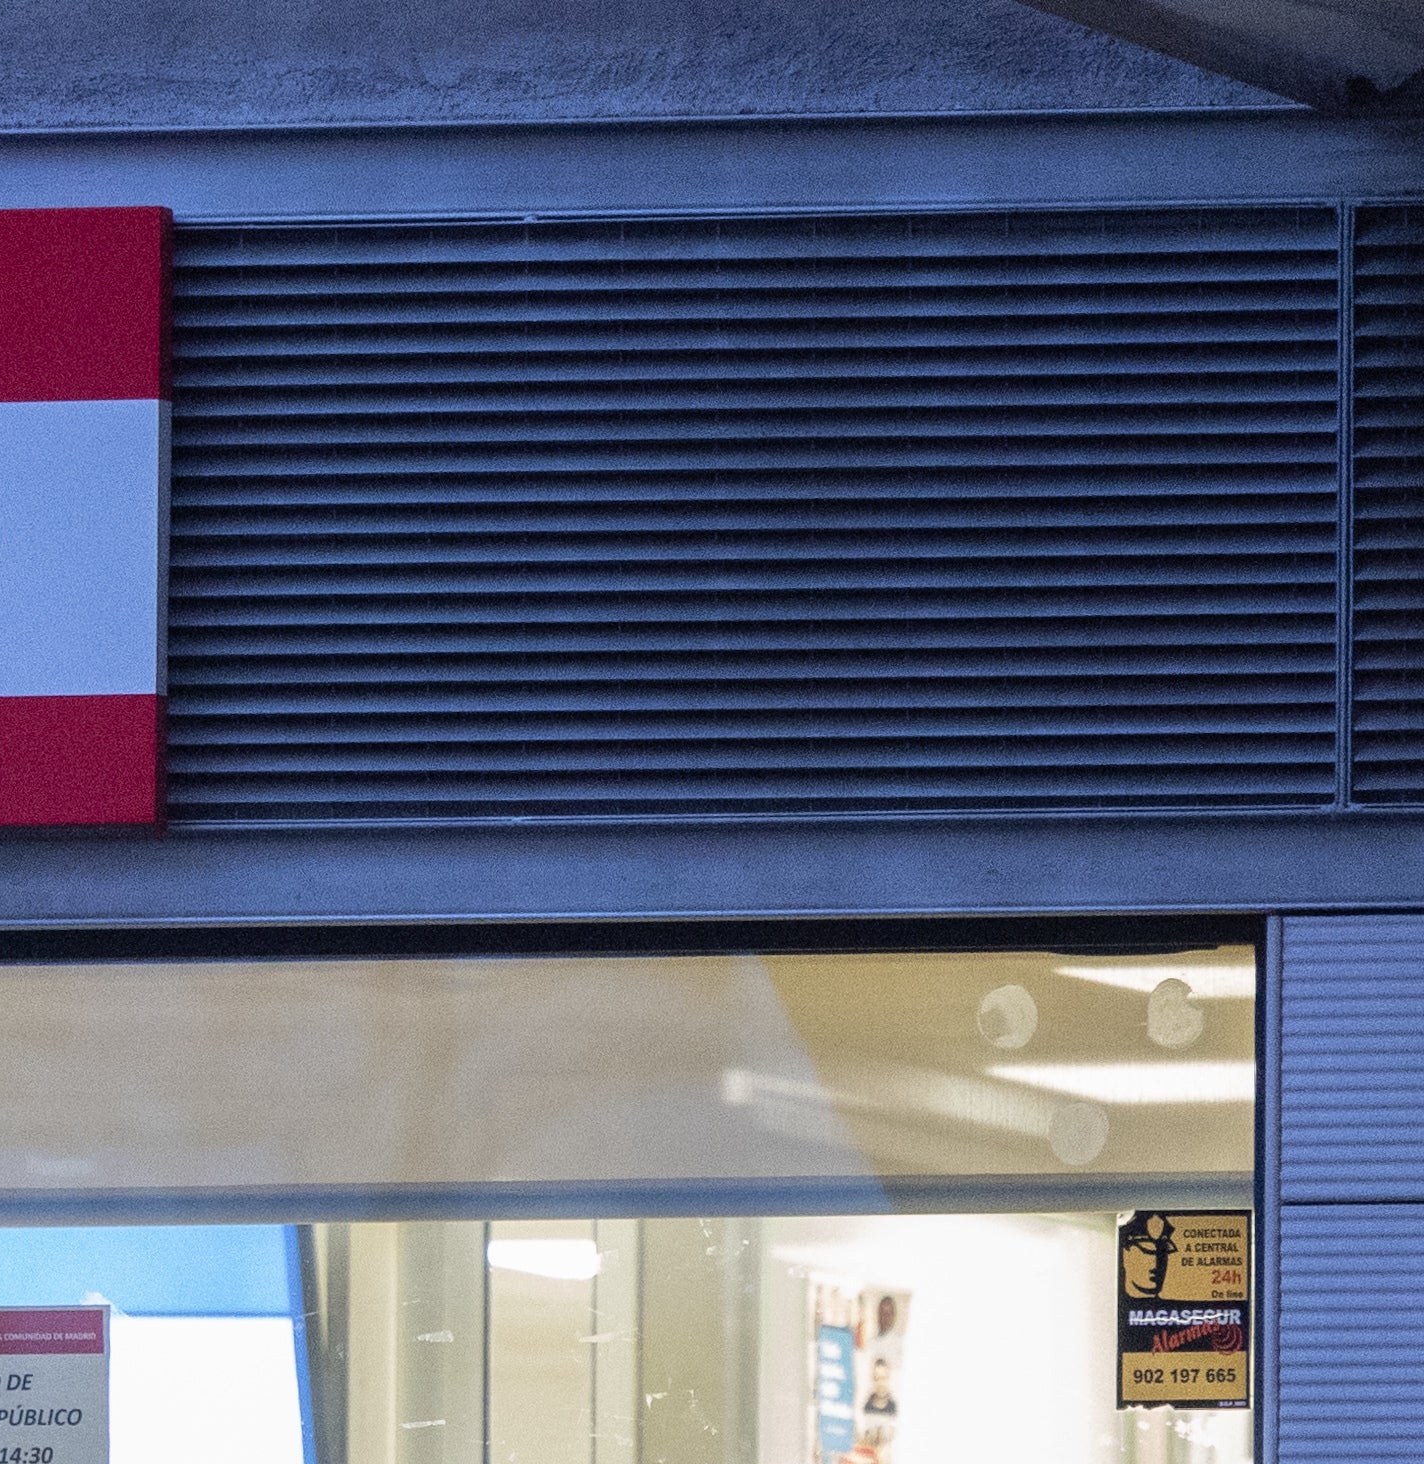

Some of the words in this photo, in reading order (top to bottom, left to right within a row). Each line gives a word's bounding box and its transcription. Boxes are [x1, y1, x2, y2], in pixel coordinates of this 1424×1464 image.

[1183, 1229, 1241, 1238] CONECTADA
[1185, 1243, 1191, 1252] A
[1194, 1243, 1239, 1252] CENTRAL
[1181, 1257, 1193, 1266] DE
[1196, 1257, 1242, 1266] ALARMAS
[1212, 1269, 1241, 1284] 24h
[1129, 1309, 1242, 1326] MAGASEGUR
[1152, 1321, 1220, 1355] Alarmas
[6, 1373, 33, 1391] DE
[1133, 1369, 1164, 1383] 902
[1170, 1369, 1200, 1383] 197
[1206, 1368, 1236, 1383] 665
[0, 1446, 53, 1464] 14:30
